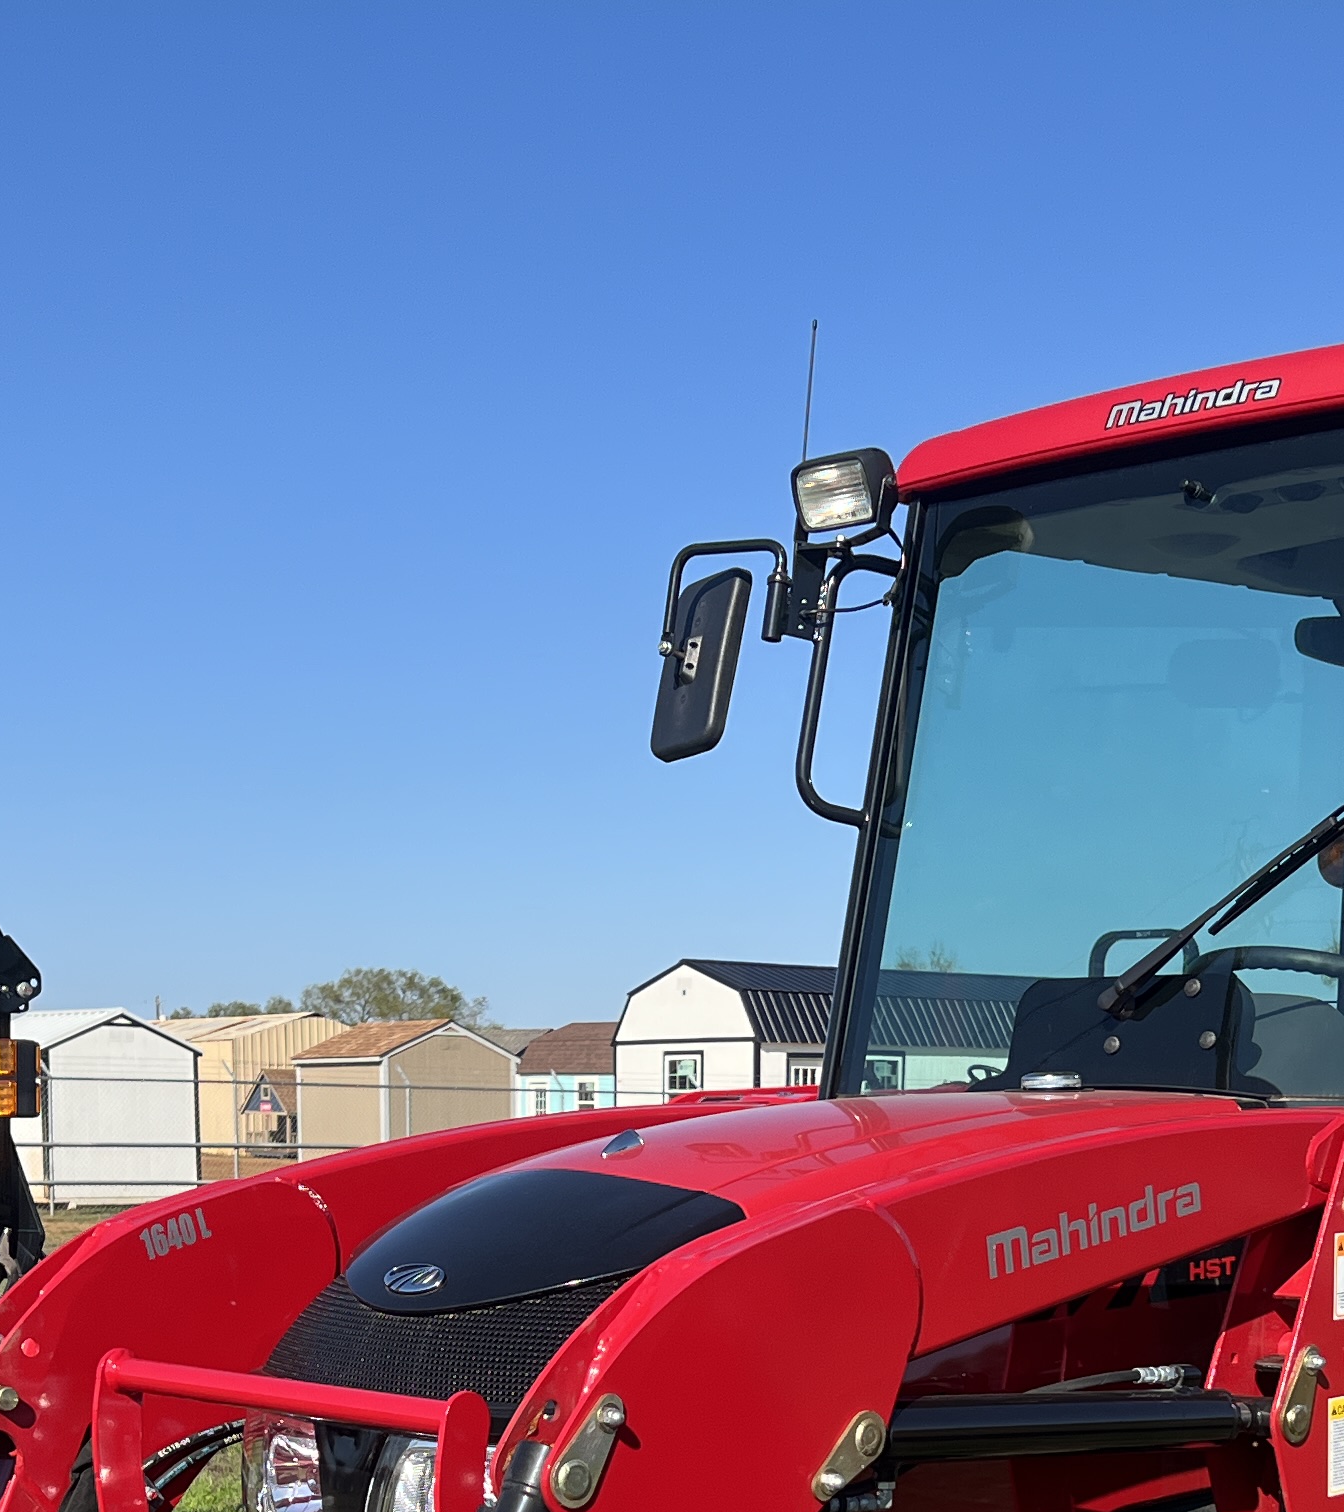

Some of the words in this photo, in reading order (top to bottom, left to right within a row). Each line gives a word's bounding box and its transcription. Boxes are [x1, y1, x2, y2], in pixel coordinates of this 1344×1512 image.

[1105, 378, 1282, 430] Mahindra
[986, 1181, 1202, 1280] Mahindra
[1189, 1256, 1236, 1281] HST
